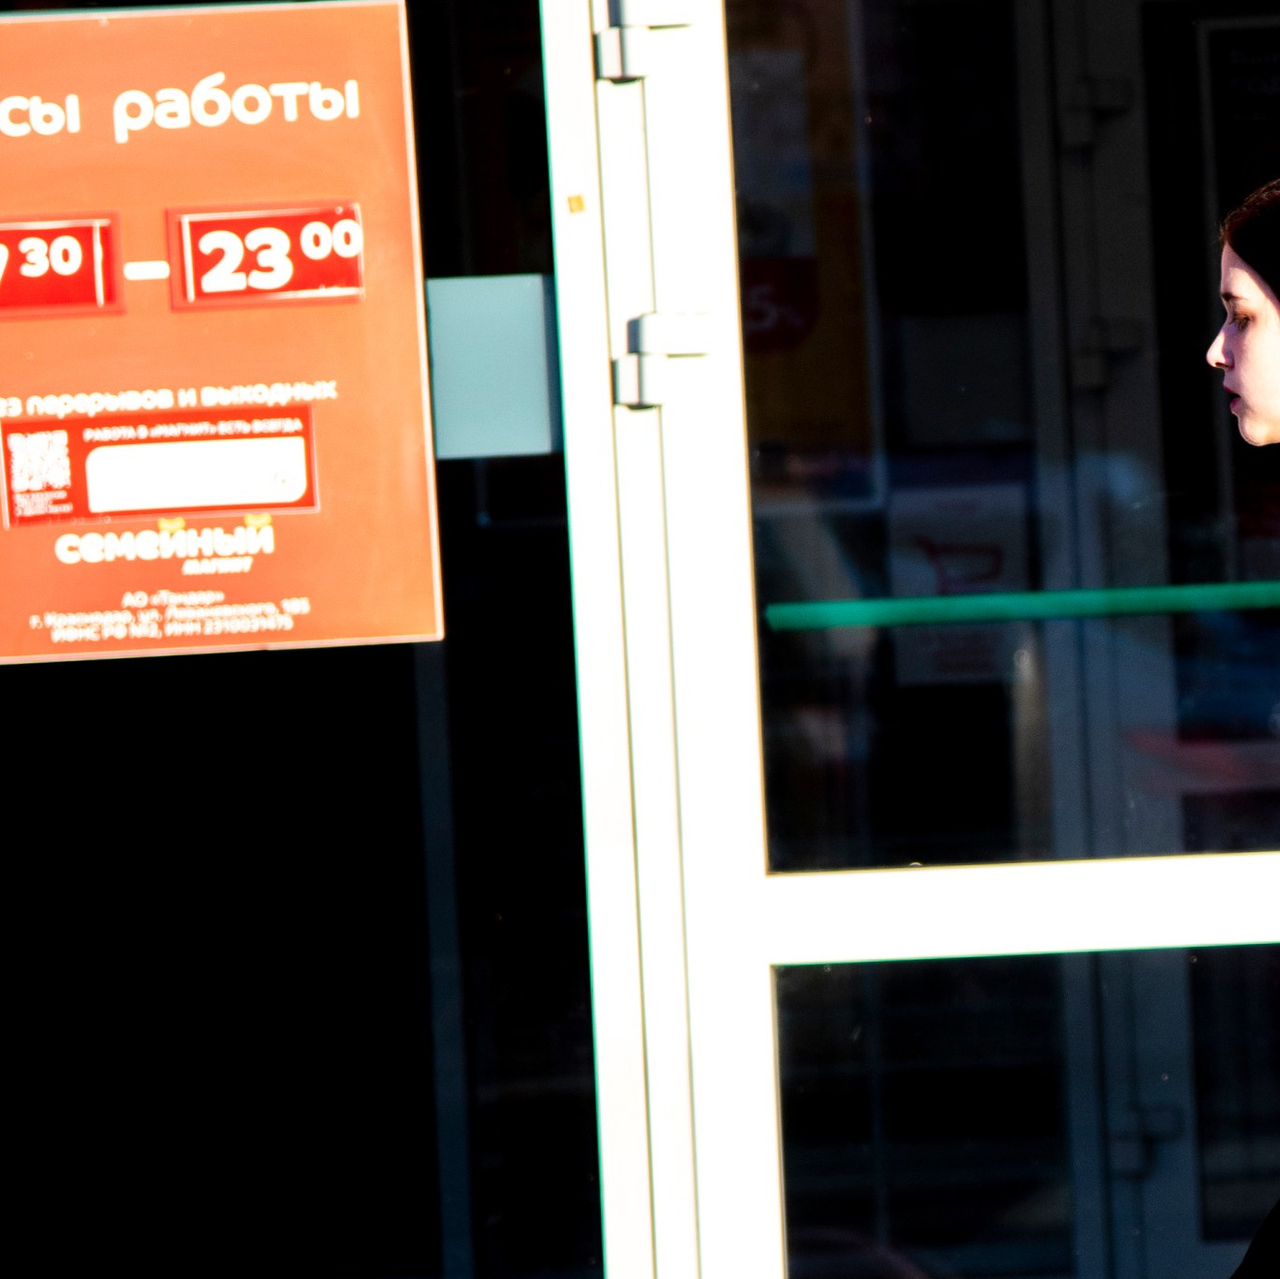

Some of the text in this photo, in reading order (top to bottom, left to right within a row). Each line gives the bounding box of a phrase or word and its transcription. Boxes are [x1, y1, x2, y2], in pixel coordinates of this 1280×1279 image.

[113, 72, 360, 145] работы
[0, 235, 82, 284] 30
[26, 389, 174, 420] перерывов
[177, 387, 197, 409] и
[201, 380, 337, 407] выходных
